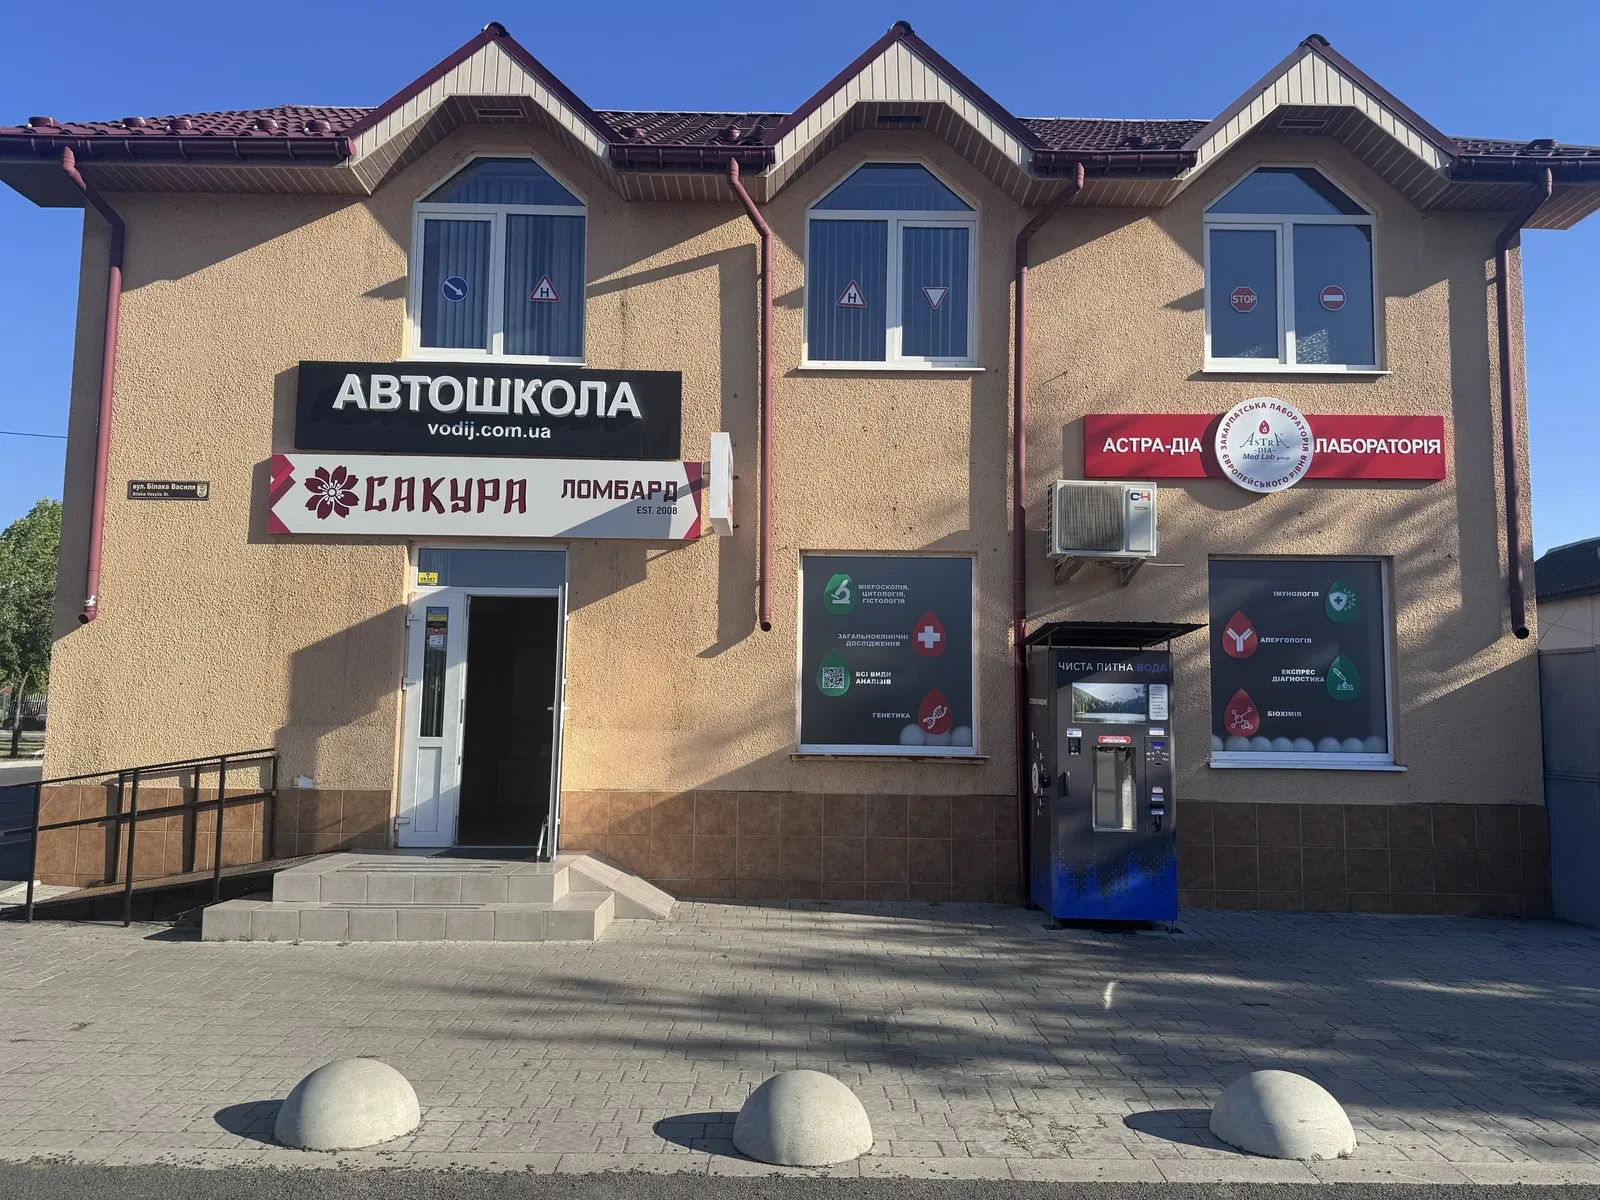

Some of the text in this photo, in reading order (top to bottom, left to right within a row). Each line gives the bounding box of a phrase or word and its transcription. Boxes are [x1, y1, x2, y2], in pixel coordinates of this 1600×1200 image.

[1232, 294, 1257, 304] STOP
[332, 373, 642, 420] АВТОШКОЛА
[427, 420, 552, 441] vodij.com.ua
[1220, 402, 1309, 452] ЗАКАРПАТСЬКА ЛАБОРАТОРІЯ
[1103, 437, 1203, 455] АСТРА-ДІА
[1314, 437, 1442, 456] ЛАБОРАТОРІЯ
[1222, 453, 1308, 488] ЄВРОПЕЙСЬКОГО РІВНЯ
[364, 475, 528, 516] САКУРА
[561, 479, 678, 502] ЛОМБАРД
[636, 506, 678, 515] EST. 2008
[1058, 662, 1167, 673] ЧИСТА ПИТНА ВОДА
